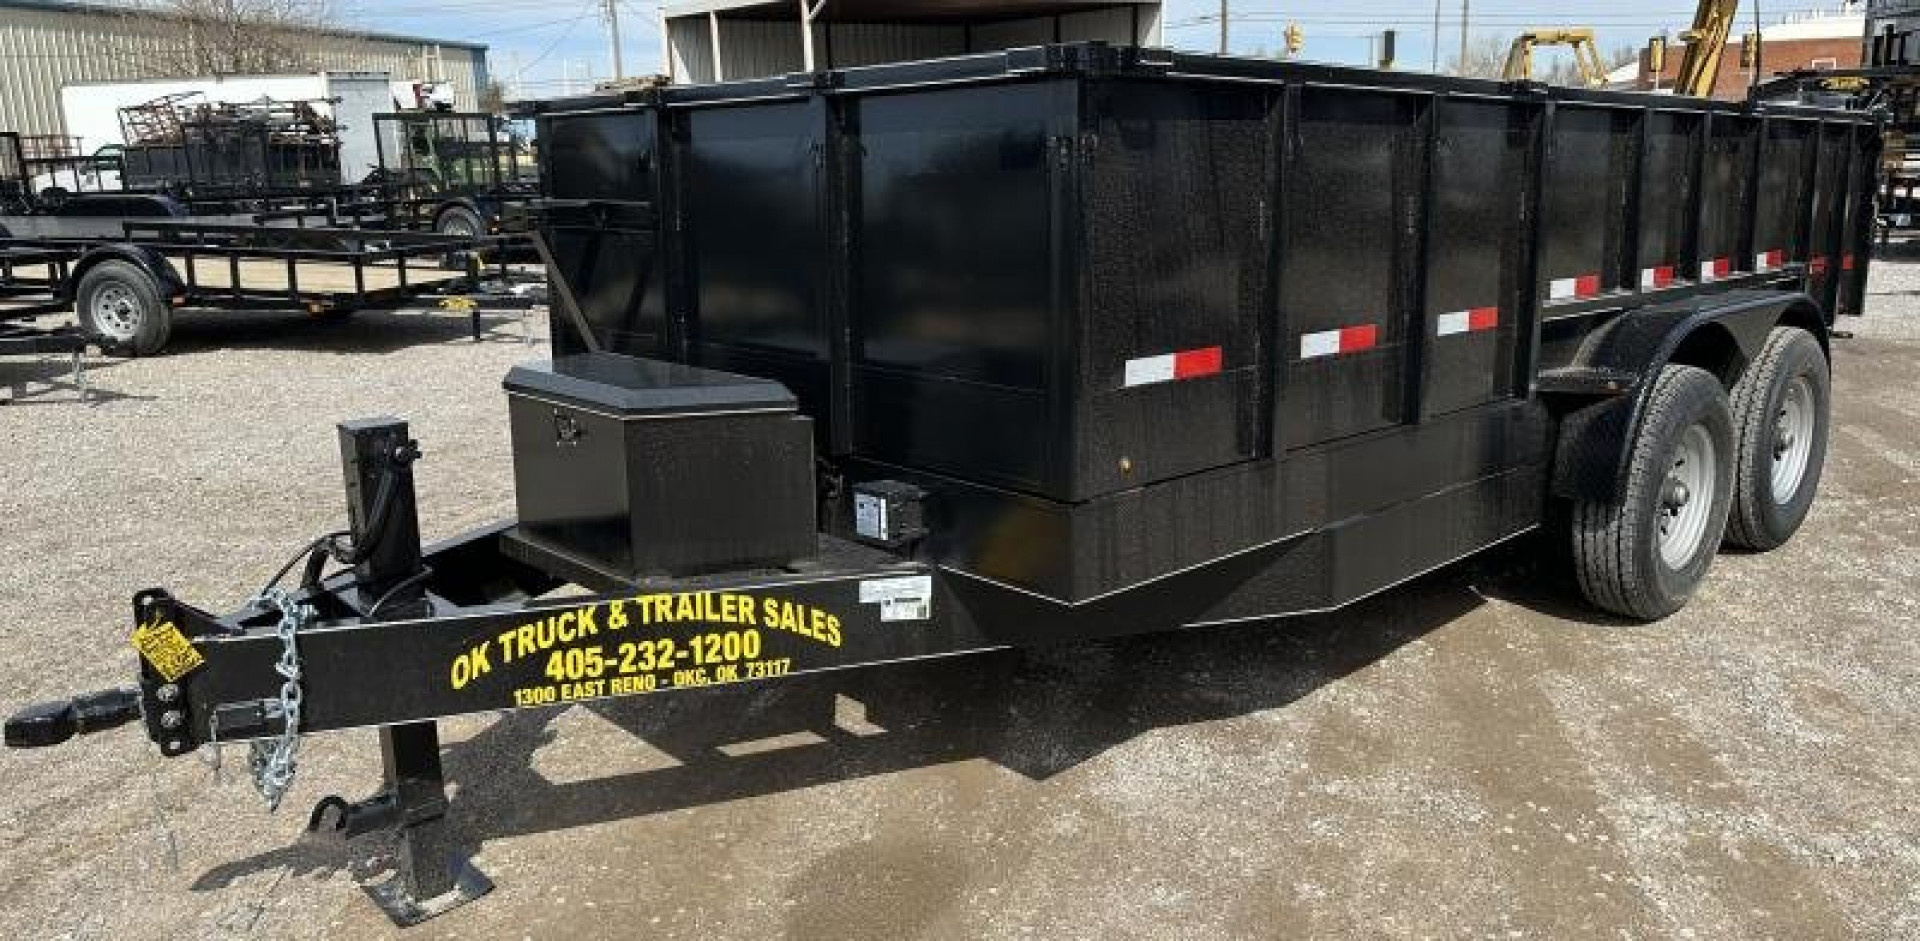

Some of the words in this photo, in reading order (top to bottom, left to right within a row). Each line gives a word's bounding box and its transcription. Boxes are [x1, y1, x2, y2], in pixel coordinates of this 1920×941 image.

[450, 641, 491, 690] OK
[498, 605, 598, 662] TRUCK
[608, 599, 628, 629] &
[636, 592, 756, 625] TRAILER
[763, 598, 842, 647] SALES
[545, 629, 761, 680] 405-232-1200
[514, 686, 555, 707] 1300
[561, 681, 605, 700] EAST
[611, 676, 656, 695] RENO
[717, 665, 738, 681] OK
[745, 658, 791, 679] 73117
